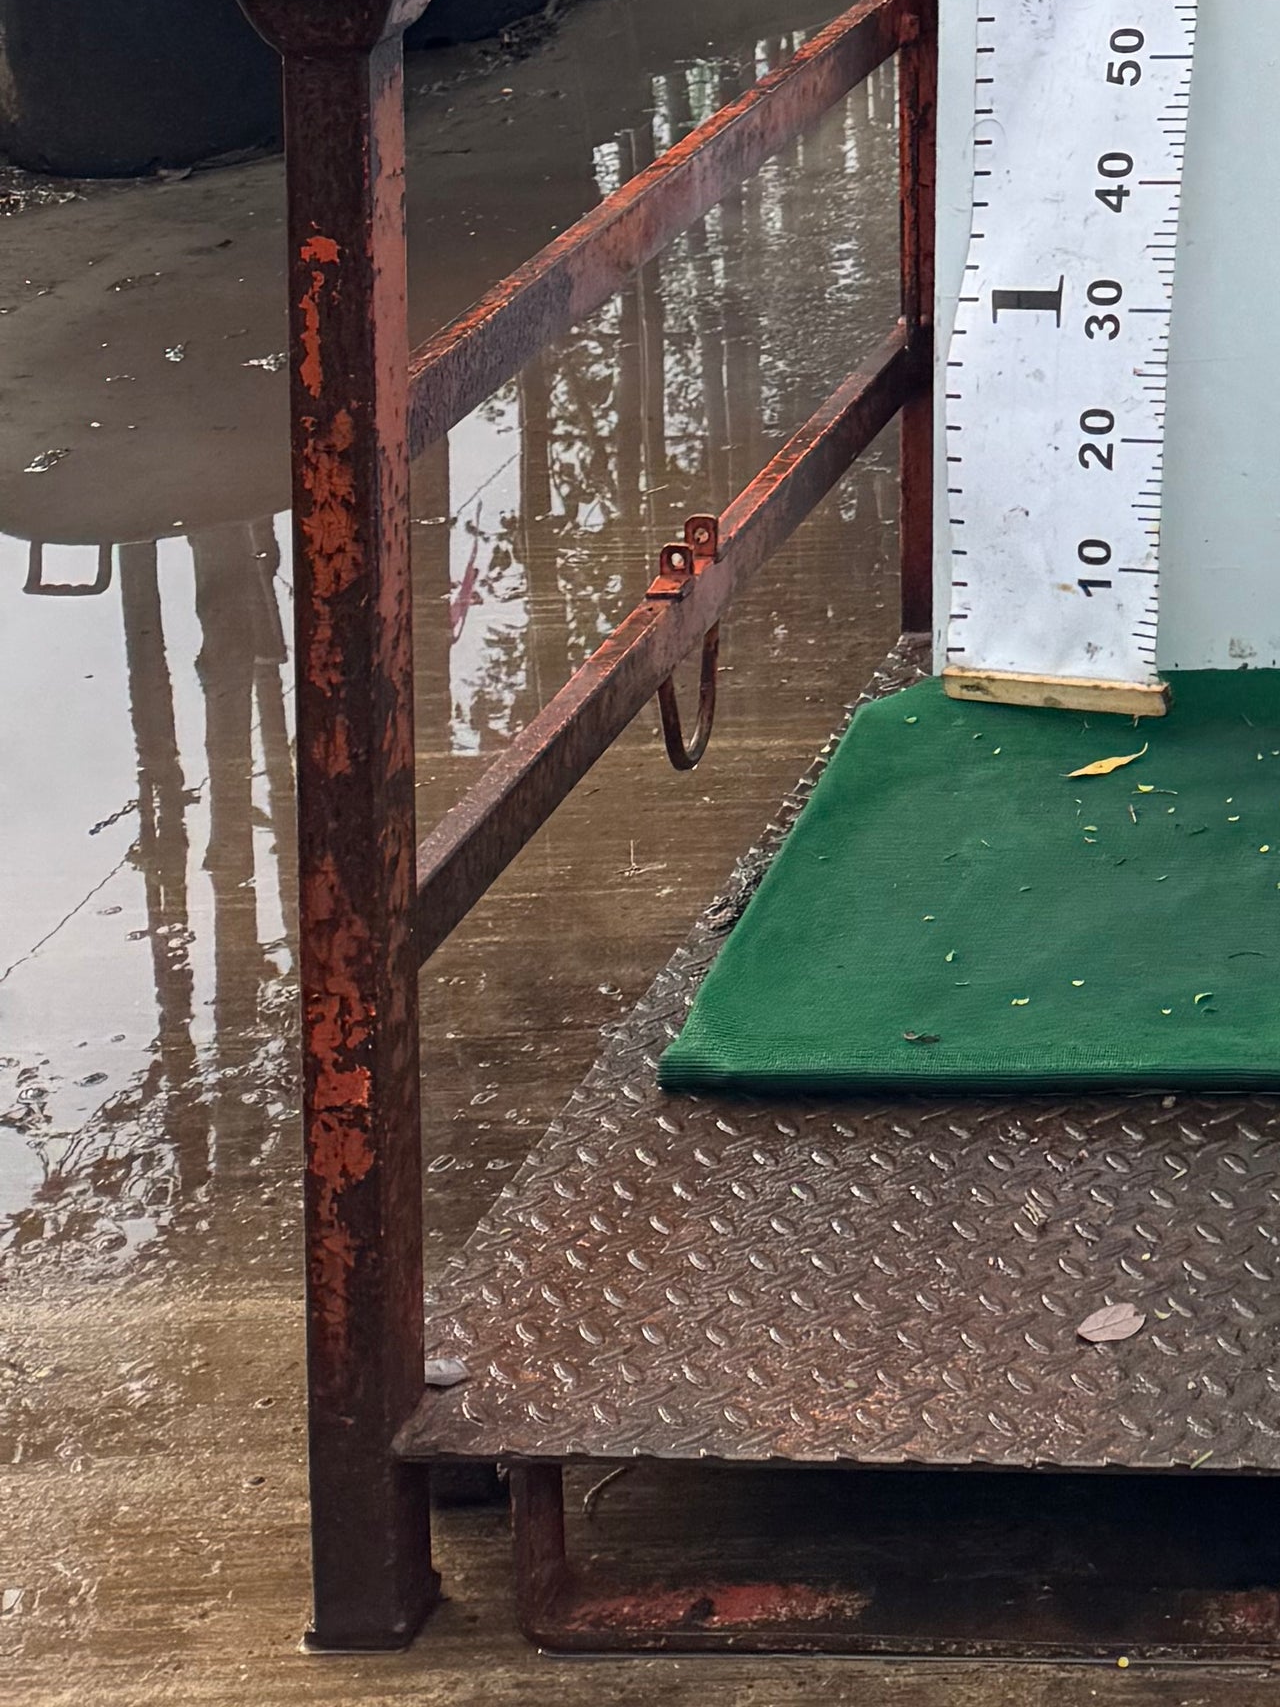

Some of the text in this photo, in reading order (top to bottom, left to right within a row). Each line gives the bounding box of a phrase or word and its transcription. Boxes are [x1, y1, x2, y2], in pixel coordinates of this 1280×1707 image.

[1105, 27, 1146, 88] 50
[1093, 151, 1135, 214] 40
[990, 273, 1065, 329] 1
[1083, 278, 1124, 342] 30
[1077, 407, 1116, 472] 20
[1076, 538, 1113, 599] 10
